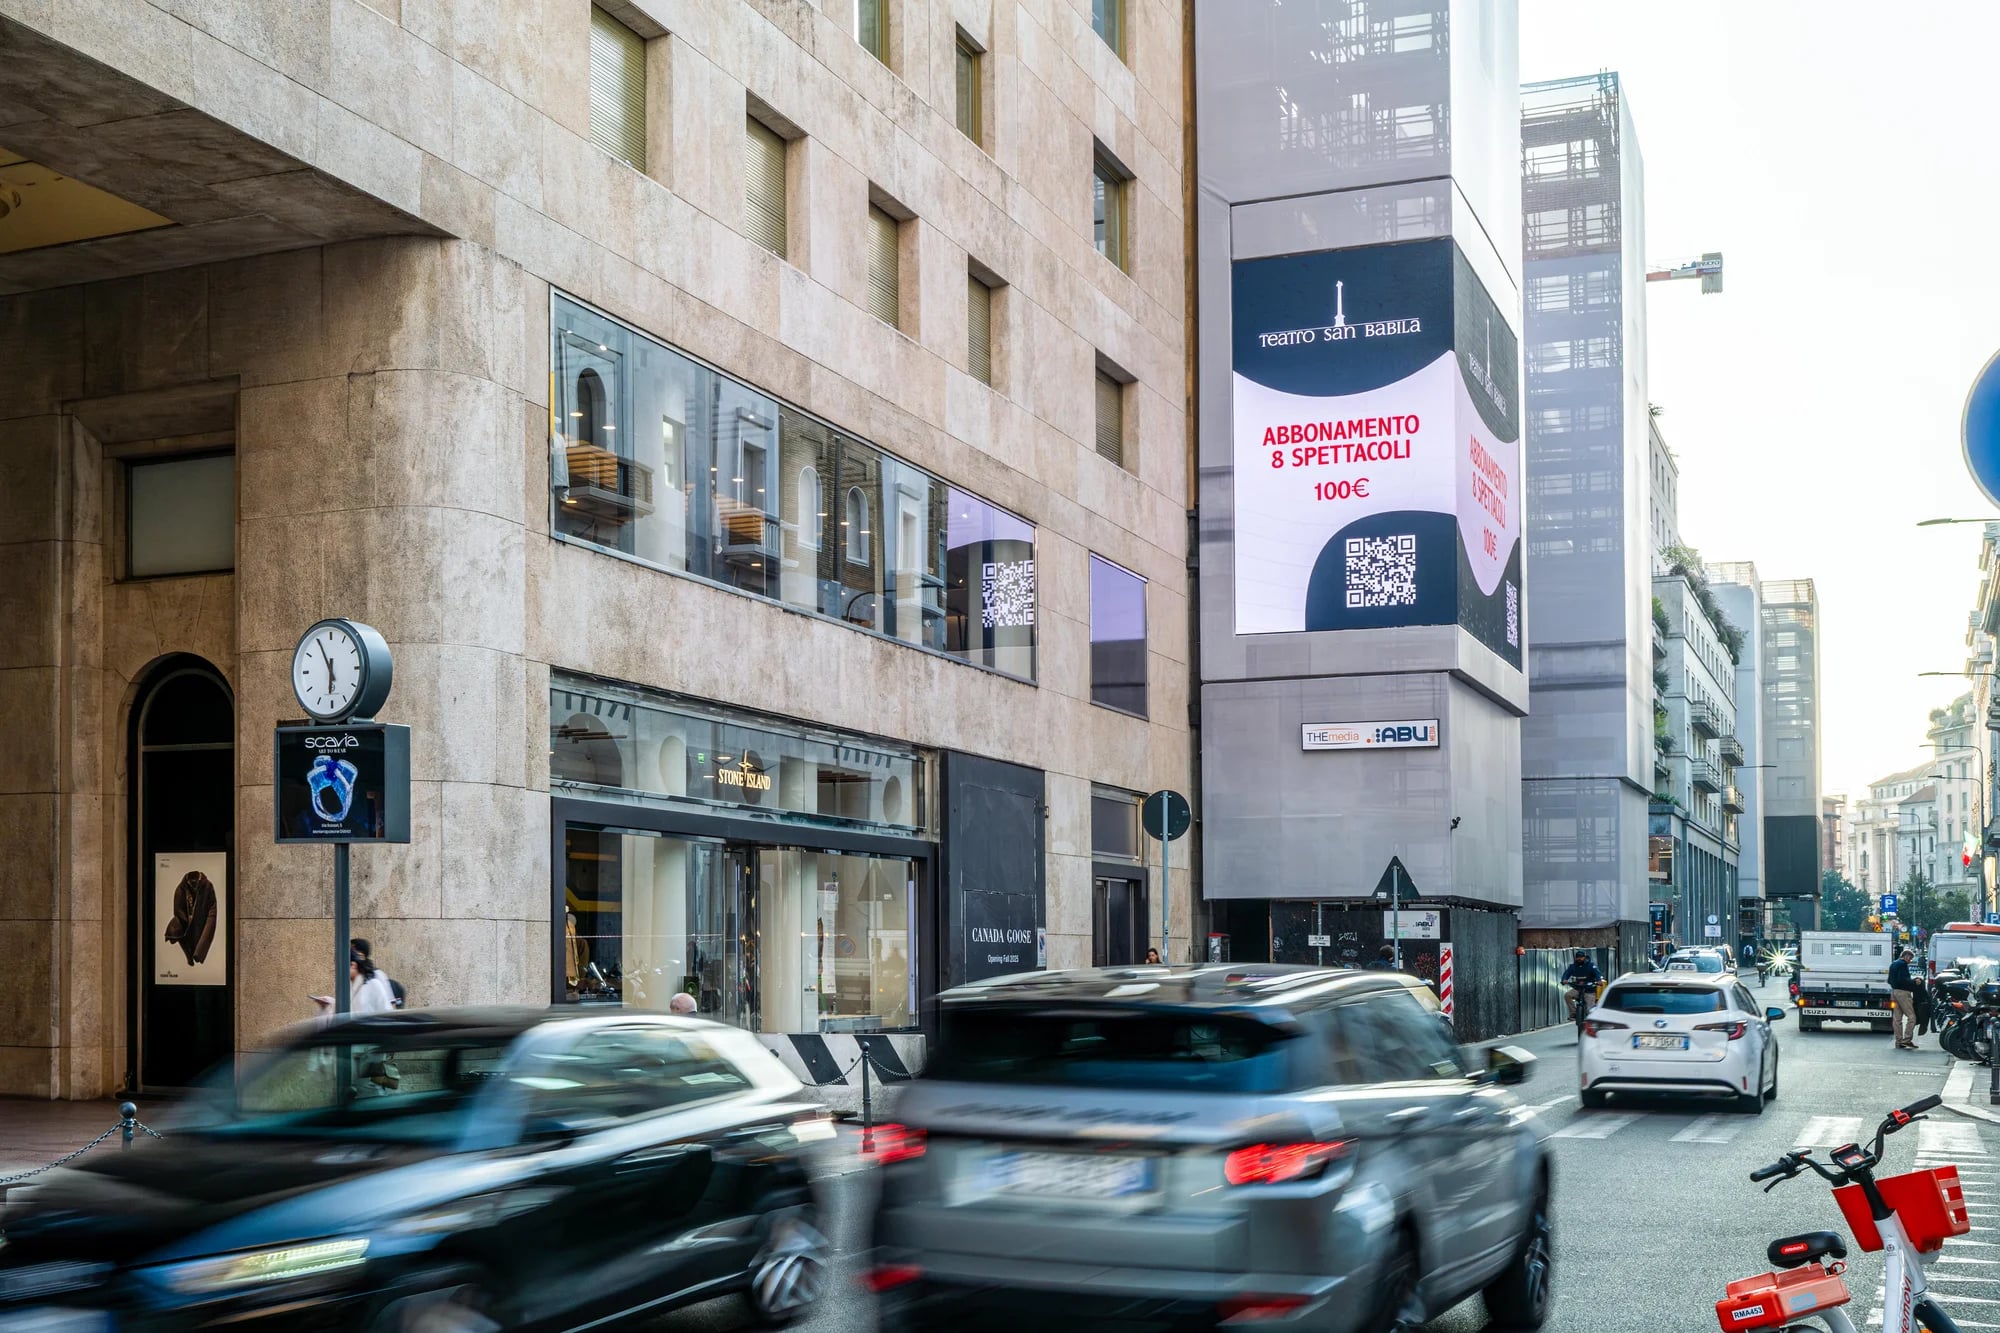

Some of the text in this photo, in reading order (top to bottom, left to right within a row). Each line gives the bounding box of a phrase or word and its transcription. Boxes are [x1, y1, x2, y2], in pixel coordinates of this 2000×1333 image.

[1262, 414, 1420, 446] ABBONAMENTO
[1271, 439, 1411, 469] 8 SPETTACOLI
[1314, 477, 1370, 501] 100€
[1306, 731, 1360, 742] THEmedia
[718, 768, 771, 790] STONE ISLAND
[972, 927, 1032, 944] CANADA GOOSE
[987, 954, 1003, 964] Opening
[1733, 1306, 1763, 1319] RMA453
